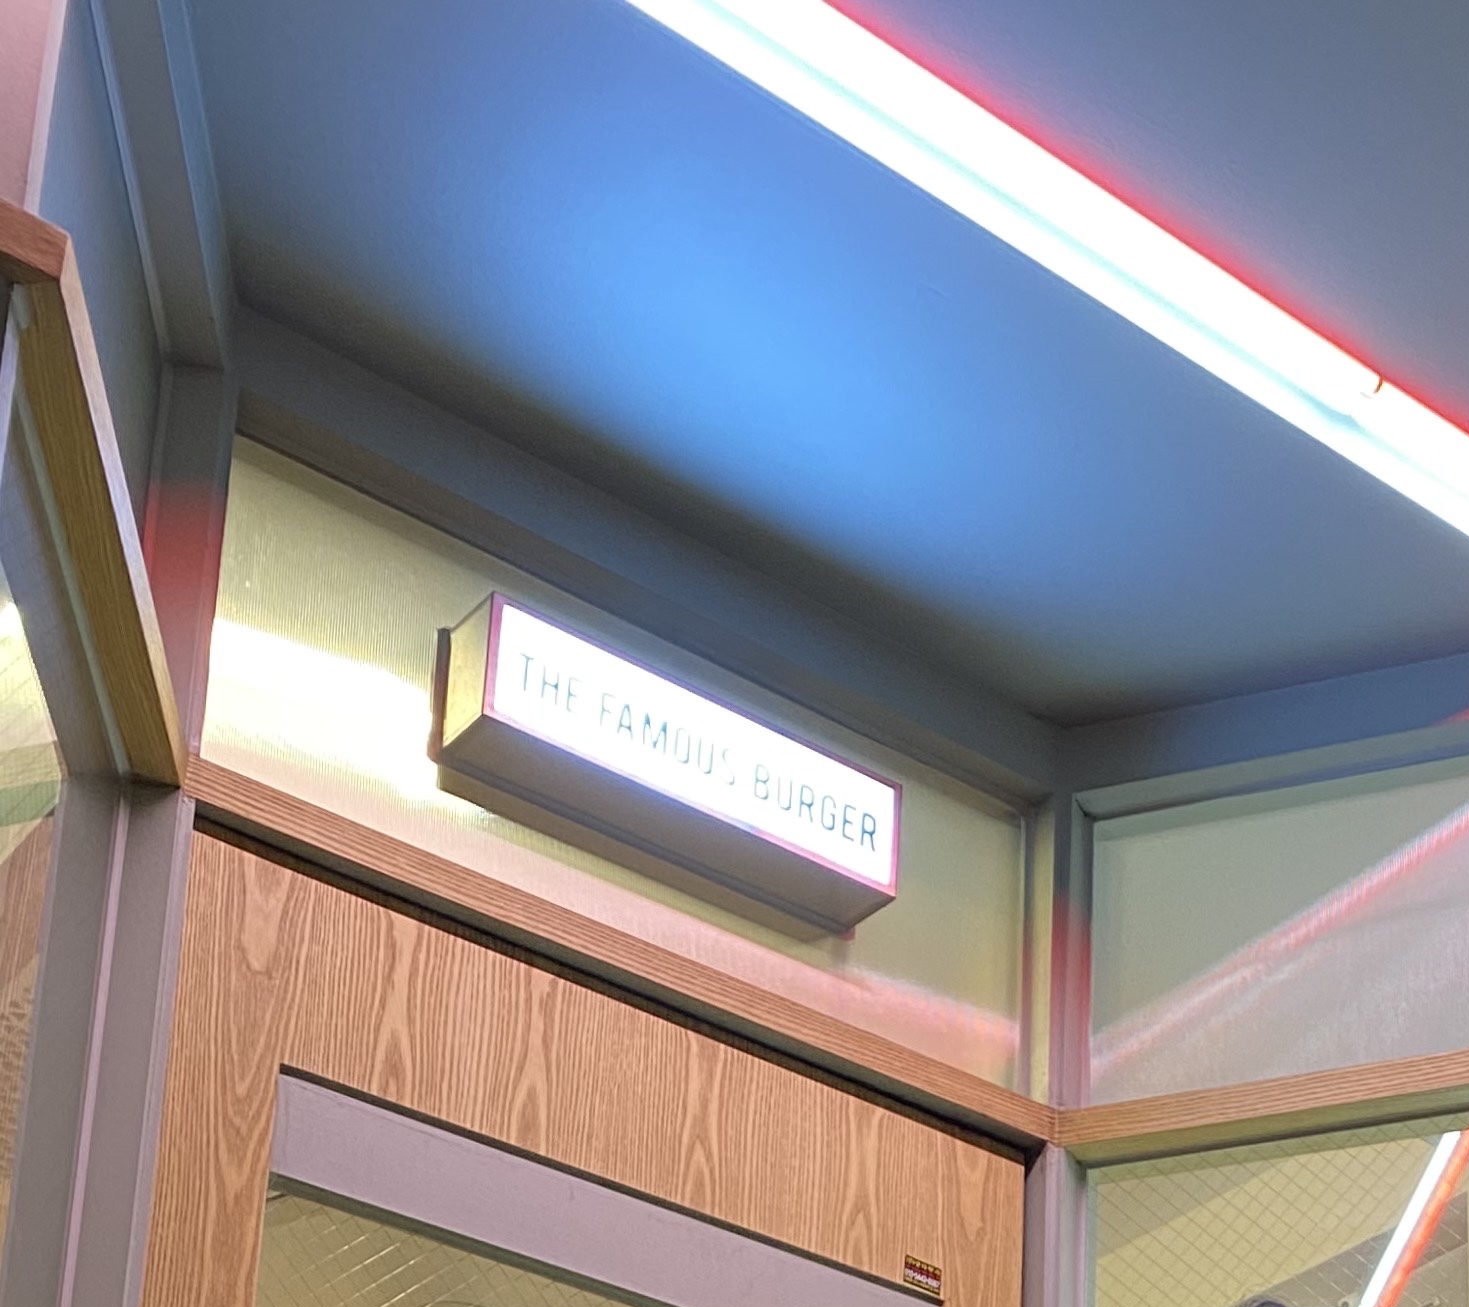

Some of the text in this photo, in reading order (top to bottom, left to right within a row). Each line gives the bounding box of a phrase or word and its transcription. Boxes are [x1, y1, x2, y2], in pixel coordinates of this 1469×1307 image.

[519, 652, 878, 852] THE FAMOUS BURGER
